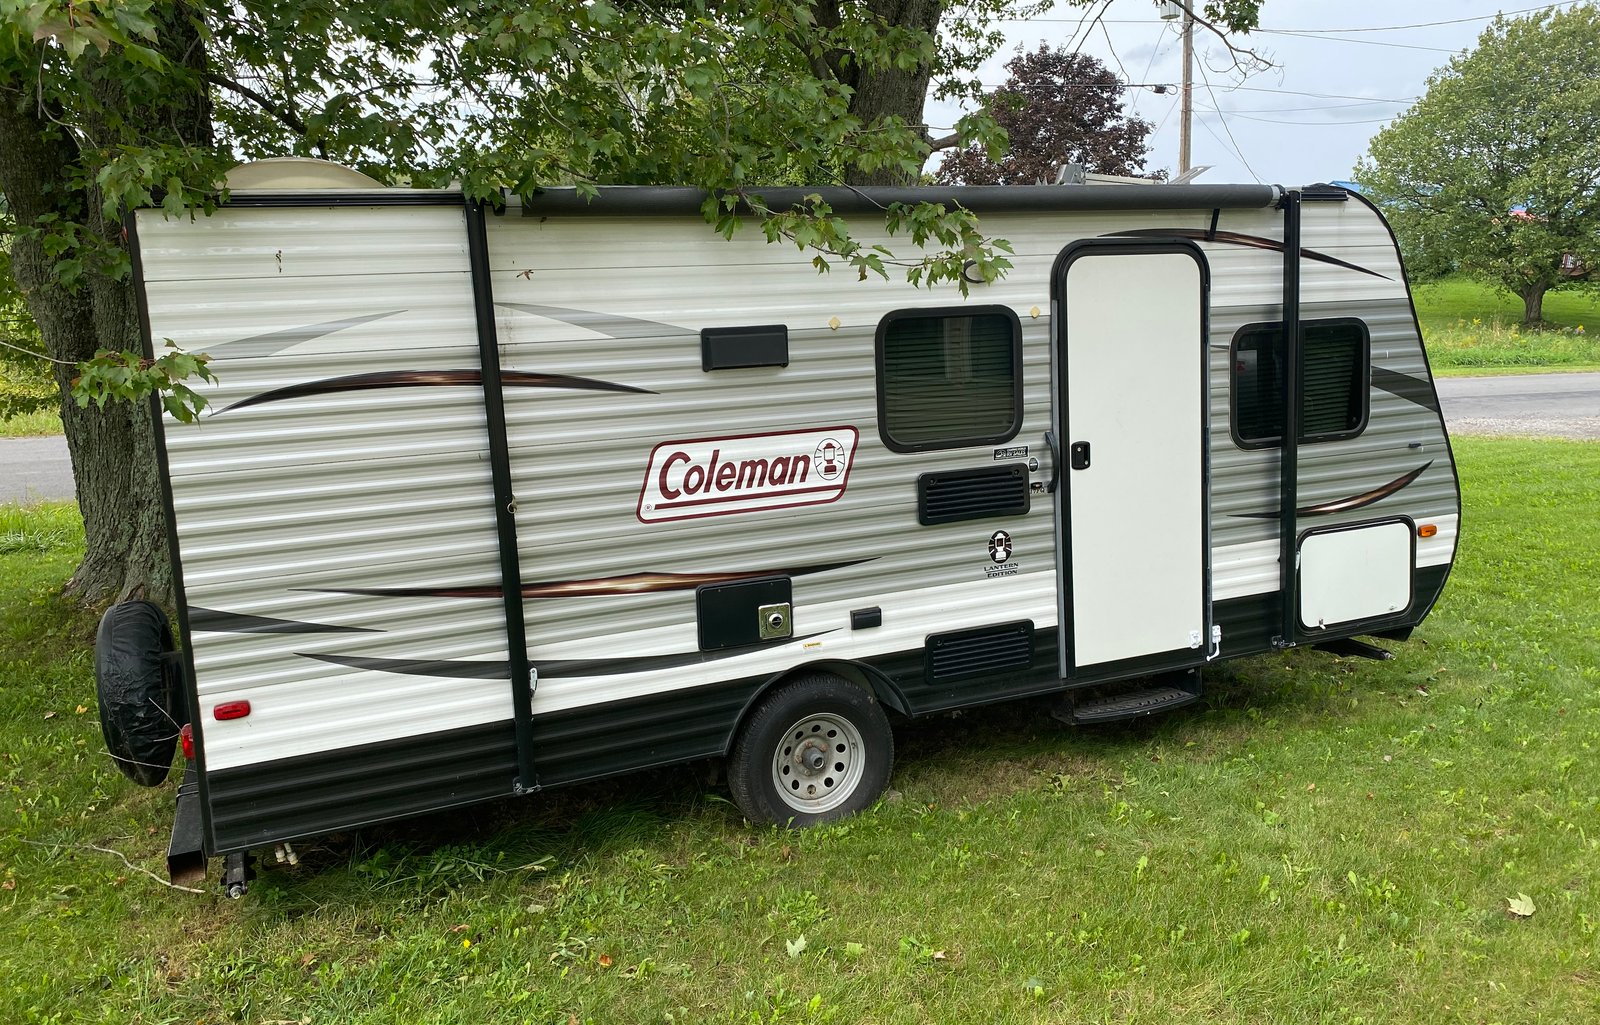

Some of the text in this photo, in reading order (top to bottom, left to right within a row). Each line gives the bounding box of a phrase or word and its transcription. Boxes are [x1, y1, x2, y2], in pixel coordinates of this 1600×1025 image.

[658, 449, 811, 500] Coleman
[983, 562, 1019, 571] LANTERN
[987, 569, 1018, 578] EDITION
